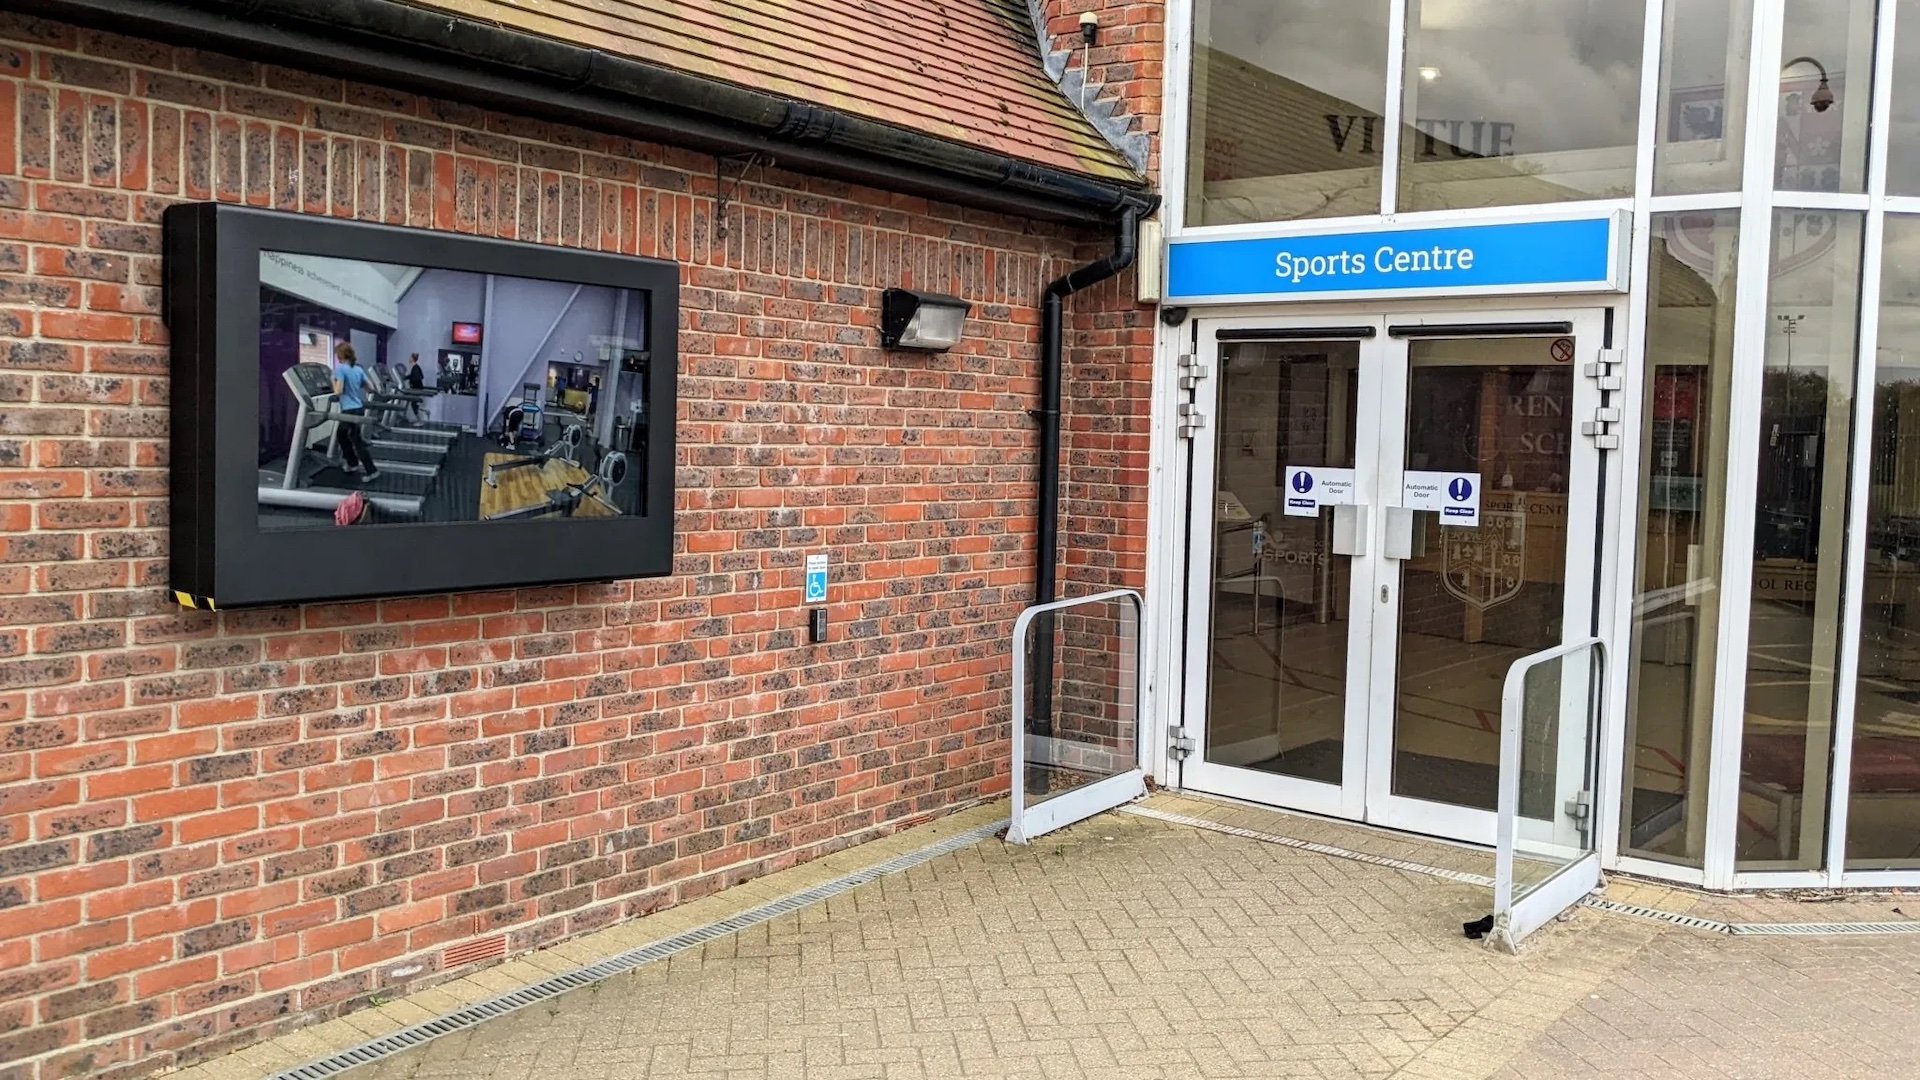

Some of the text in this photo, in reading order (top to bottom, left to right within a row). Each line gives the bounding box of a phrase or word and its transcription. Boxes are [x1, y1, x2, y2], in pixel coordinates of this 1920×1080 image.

[1324, 114, 1515, 157] VITUE
[1275, 245, 1474, 284] Sports Centre
[1321, 480, 1352, 488] Automatic
[1328, 486, 1344, 494] Door
[1405, 483, 1439, 491] Automatic
[1261, 548, 1327, 566] SPORTS
